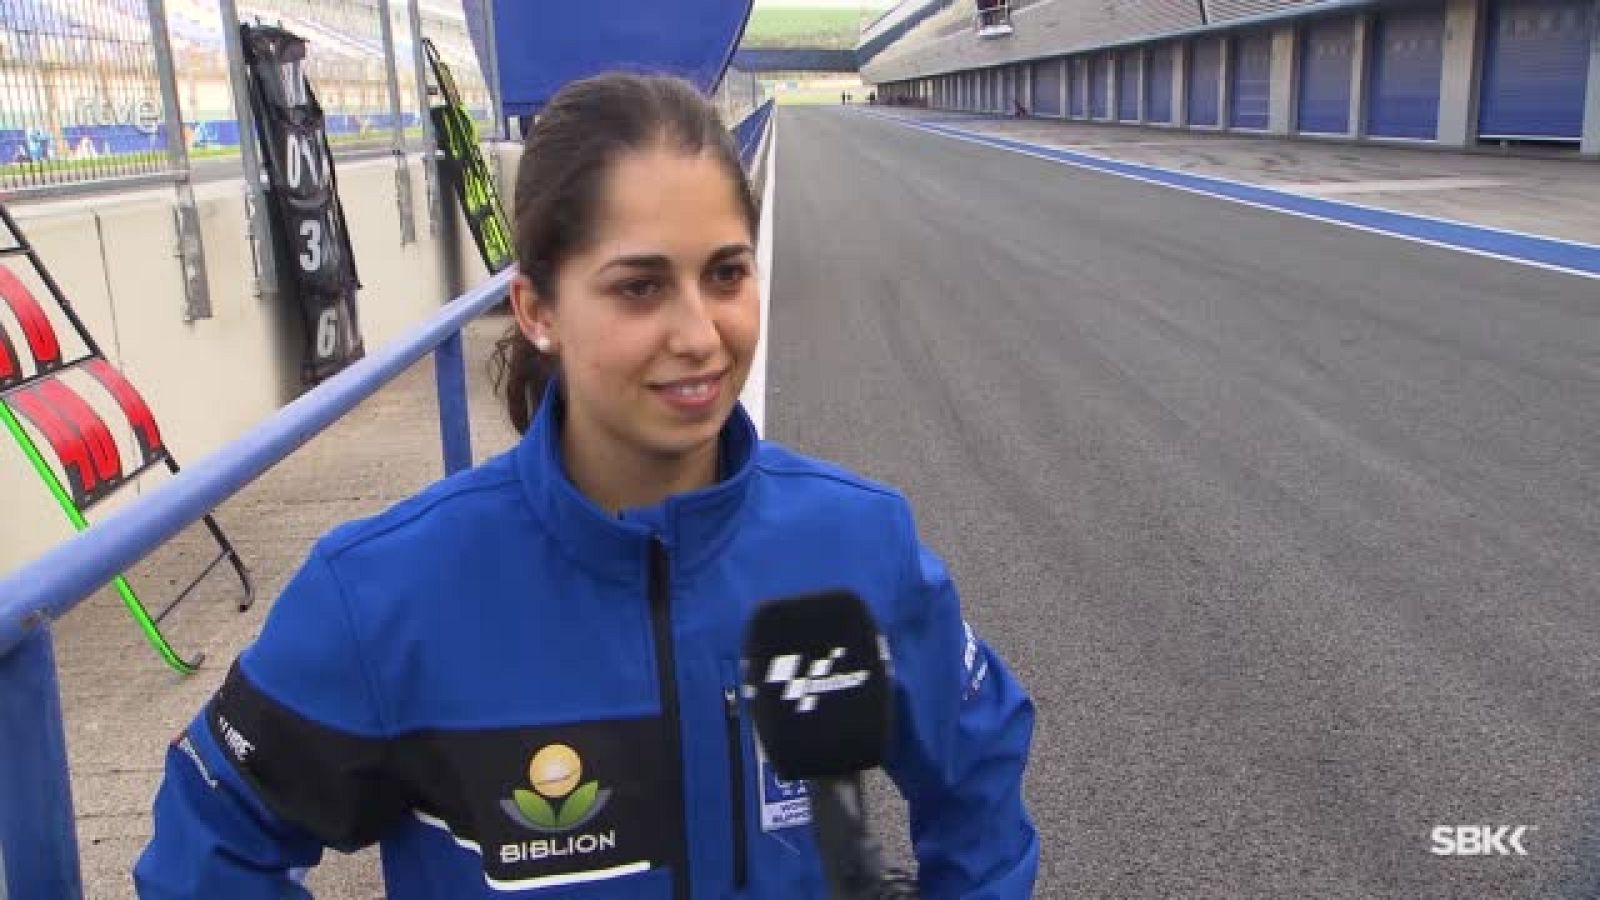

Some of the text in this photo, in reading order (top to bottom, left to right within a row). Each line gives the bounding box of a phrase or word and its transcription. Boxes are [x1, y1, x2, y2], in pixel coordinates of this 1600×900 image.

[299, 219, 321, 272] 3
[316, 308, 336, 358] 6
[499, 829, 616, 863] BIBLION
